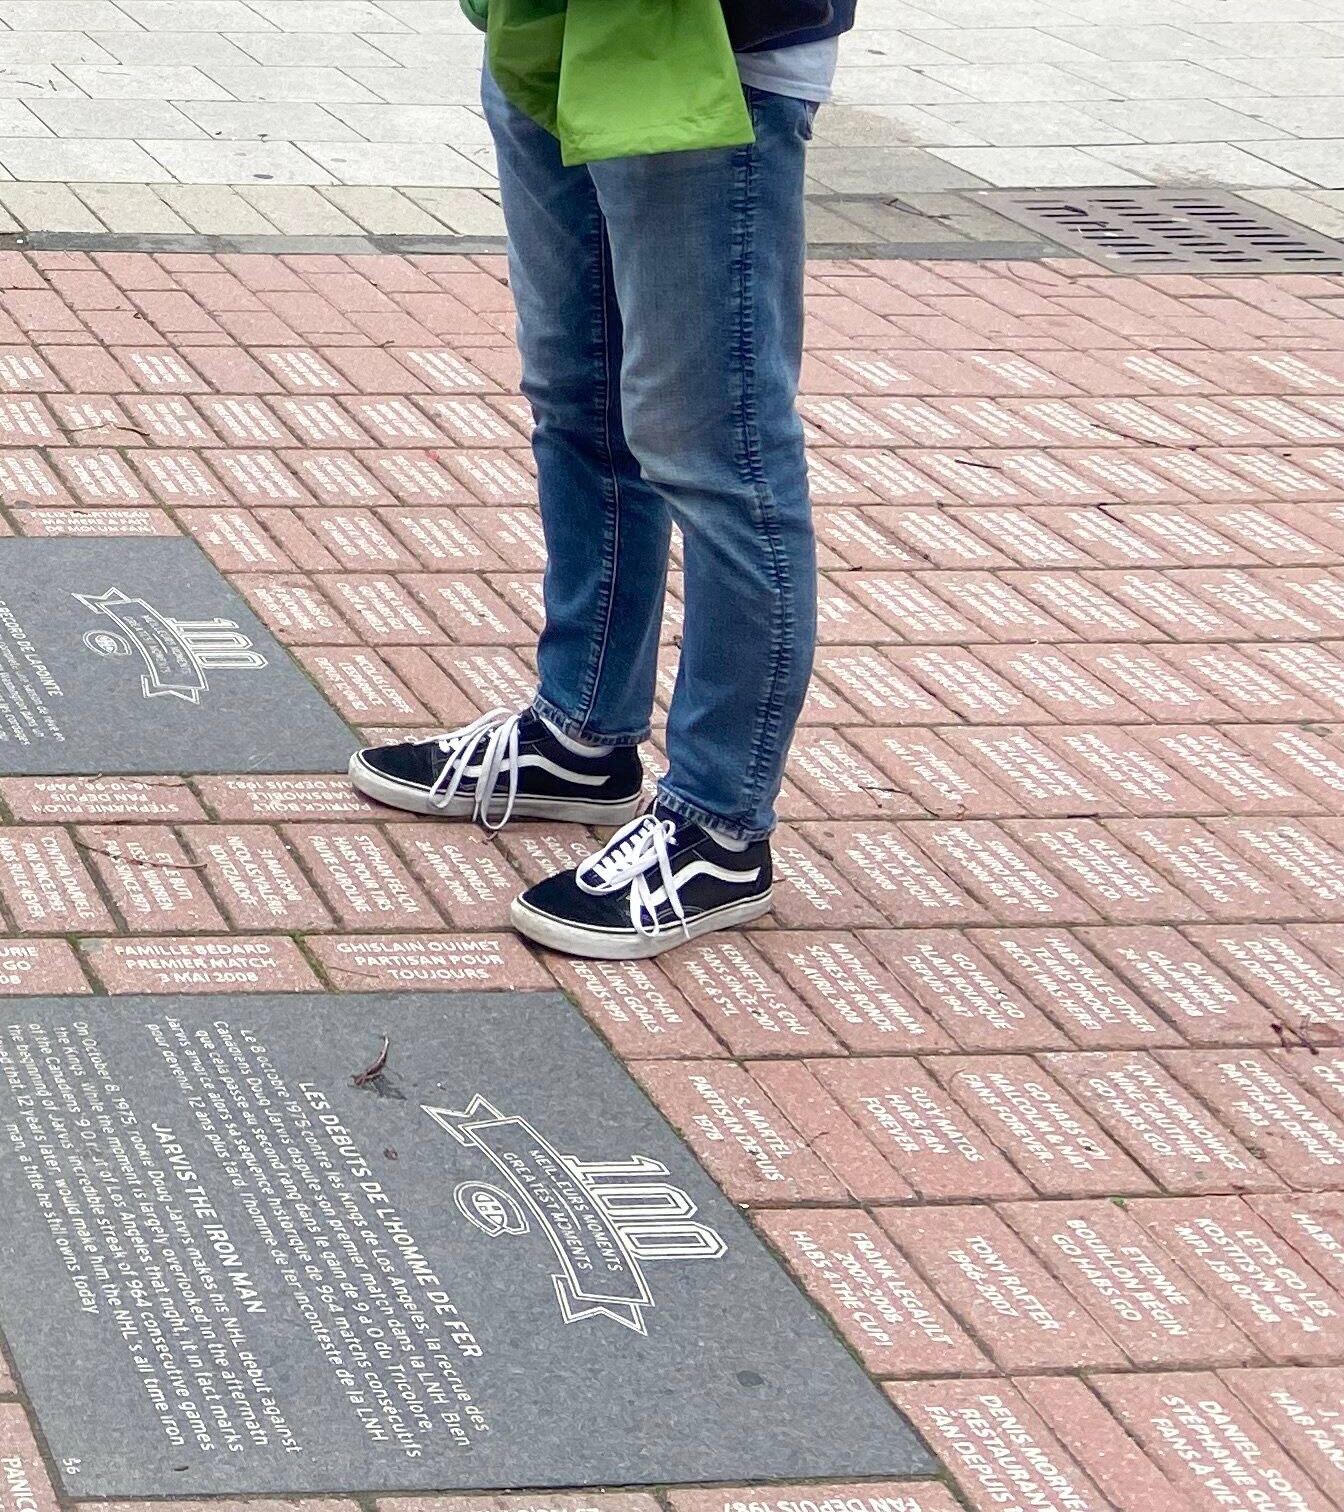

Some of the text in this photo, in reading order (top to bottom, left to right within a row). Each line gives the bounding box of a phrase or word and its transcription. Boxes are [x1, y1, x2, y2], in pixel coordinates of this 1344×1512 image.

[15, 641, 35, 651] DE
[167, 617, 269, 669] 100
[23, 654, 62, 695] LAPOINTE
[2, 961, 31, 971] GO
[114, 944, 192, 956] FAMILLE
[126, 957, 276, 970] PREMIER MATCH
[336, 940, 500, 953] GHISLAIN OUIMET
[355, 954, 504, 966] PARTISAN POUR
[161, 971, 258, 984] 3 MAI 2008
[388, 969, 490, 980] TOUJOURS
[687, 1076, 786, 1179] PARTISAN DEPUIS
[691, 1115, 725, 1139] 1978
[740, 1109, 795, 1157] MARTEL
[151, 1123, 266, 1312] JARVIS THE IRON MAN
[299, 1083, 483, 1356] LES DÉBUTS DE L'HOMME DE FER
[502, 1152, 594, 1271] GREATEST MOMENTS
[529, 1152, 625, 1272] MEILLEURS MOMENTS
[566, 1154, 730, 1258] 100
[847, 1233, 900, 1277] FRANK
[1049, 1234, 1144, 1320] GO HABS GO
[1065, 1220, 1145, 1288] BOUILLON
[788, 1231, 894, 1345] HABS 4 THE CUP!
[946, 1250, 1018, 1315] 1966-2007
[963, 1236, 1064, 1332] TONY RAFTER
